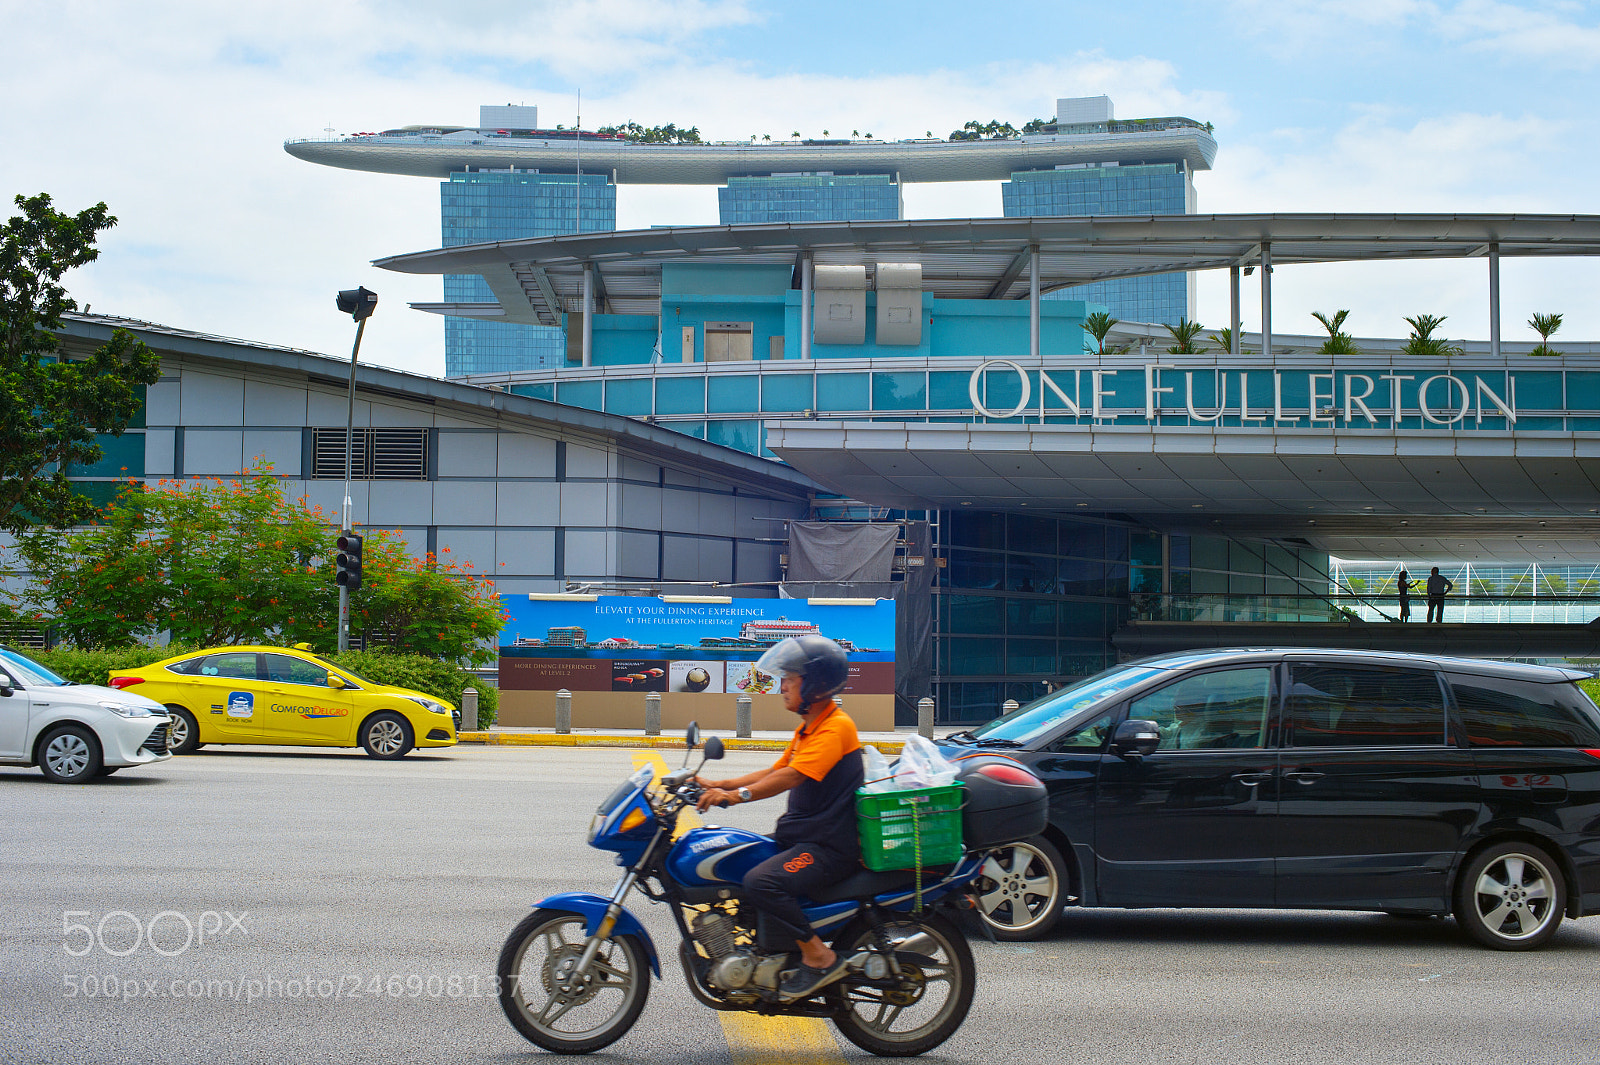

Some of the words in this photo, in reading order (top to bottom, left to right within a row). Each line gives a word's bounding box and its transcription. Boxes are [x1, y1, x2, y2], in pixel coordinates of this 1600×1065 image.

[968, 359, 1118, 420] ONE
[1144, 363, 1517, 425] FULLERTON
[595, 605, 633, 614] ELEVATE
[636, 606, 665, 615] YOUR
[668, 606, 705, 615] DINING
[708, 607, 765, 616] EXPERIENCE
[653, 617, 696, 625] FULLERTON
